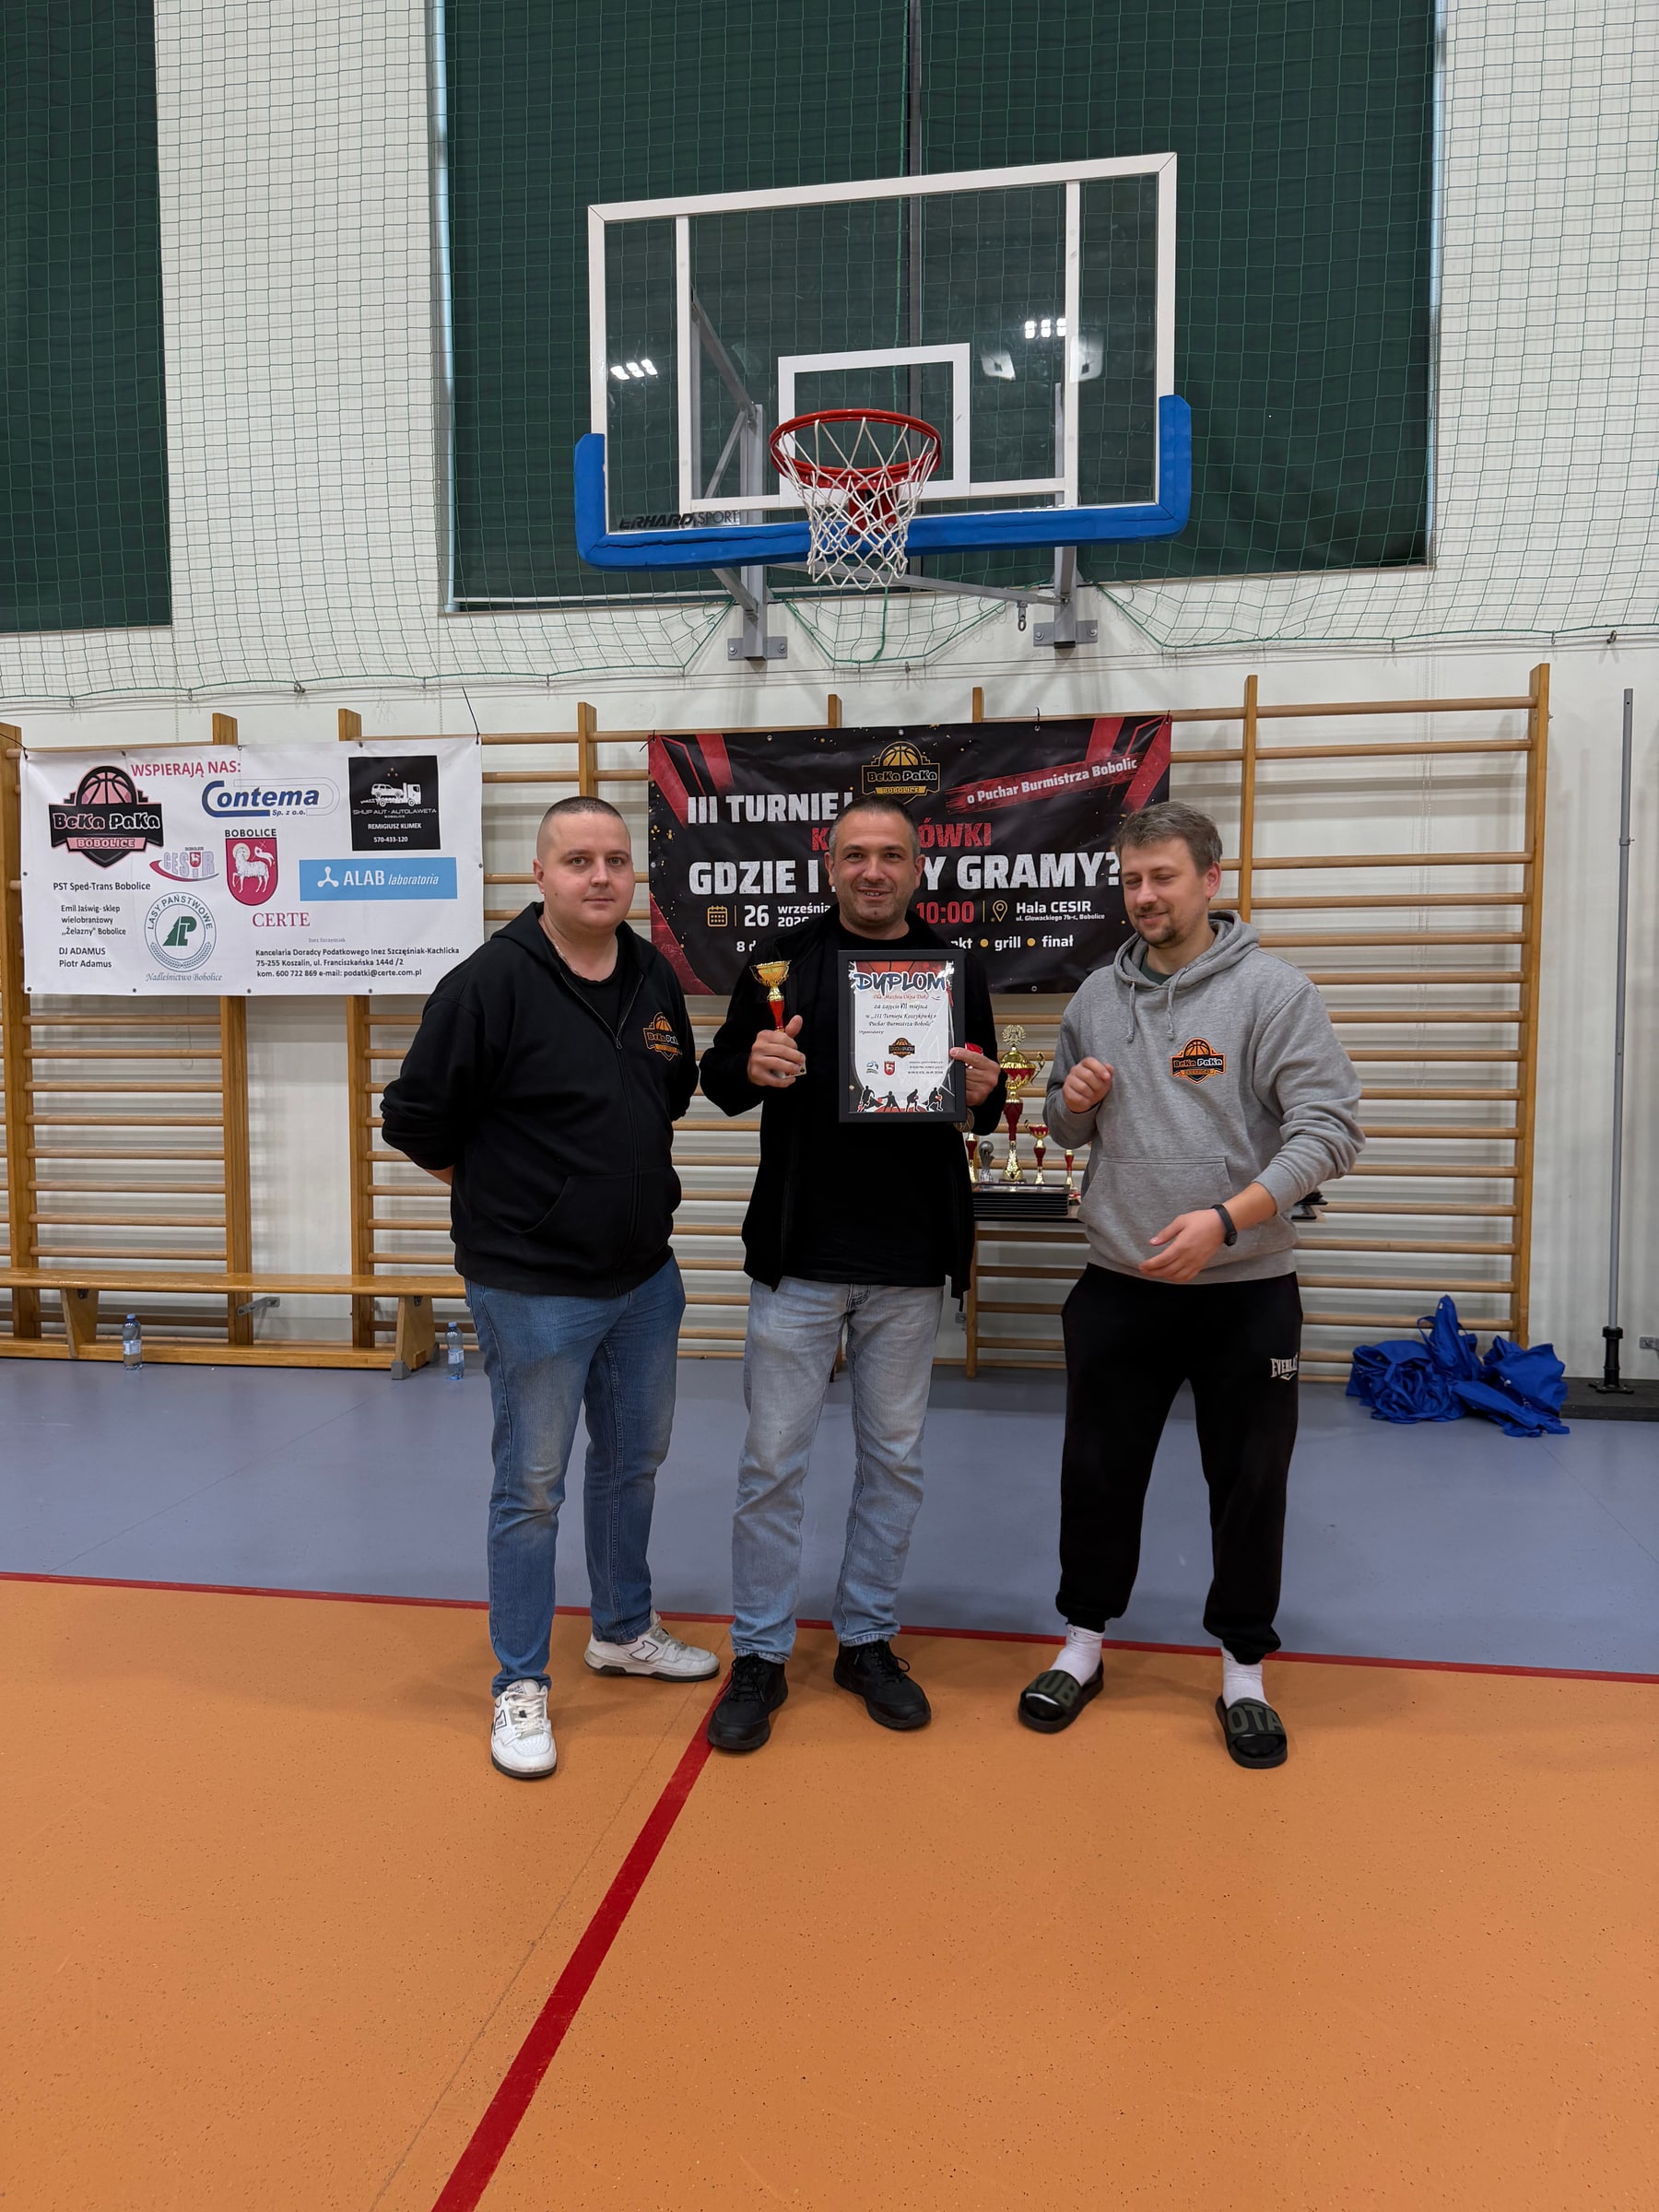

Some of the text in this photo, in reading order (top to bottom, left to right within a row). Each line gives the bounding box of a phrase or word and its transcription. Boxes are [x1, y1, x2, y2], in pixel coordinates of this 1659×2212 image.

[698, 510, 739, 524] SPORT
[131, 760, 241, 778] WSPIERAJĄ NAS:
[867, 770, 938, 782] BeKa PaKa
[967, 758, 1138, 804] o Puchar Burmistrza Bobolic
[201, 780, 320, 818] Contema
[272, 809, 284, 818] Sp.
[688, 795, 718, 824] III
[53, 812, 161, 830] BeKa PaKa
[225, 829, 276, 838] BOBOLICE
[76, 838, 135, 848] BOBOLICE
[343, 870, 439, 887] ALAB laboratoria
[688, 859, 796, 895] GDZIE
[807, 859, 819, 893] I
[957, 852, 1121, 890] GRAMY?
[53, 881, 151, 892] PST Sped-Trans Bobolice
[61, 904, 76, 912] Emil
[102, 904, 121, 913] sklep
[147, 893, 214, 930] LASY PAŃSTWOWE
[1016, 900, 1091, 913] Hala CESIR
[61, 916, 113, 925] wielobranżowy
[252, 912, 311, 927] CERTE
[744, 905, 770, 927] 26
[98, 927, 126, 935] Bobolice
[736, 941, 746, 952] 8
[994, 935, 1021, 952] grill
[1041, 935, 1074, 948] finał
[58, 947, 106, 955] DJ ADAMUS
[292, 948, 322, 957] Doradcy
[323, 947, 370, 957] Podatkowego
[59, 959, 112, 968] Piotr Adamus
[281, 959, 312, 967] Koszalin,
[376, 958, 394, 966] 144d
[319, 969, 342, 977] e-mail:
[344, 968, 422, 977] podatki@certe.com.pl
[853, 971, 947, 997] DYPLOM
[1227, 1704, 1285, 1735] OTA
